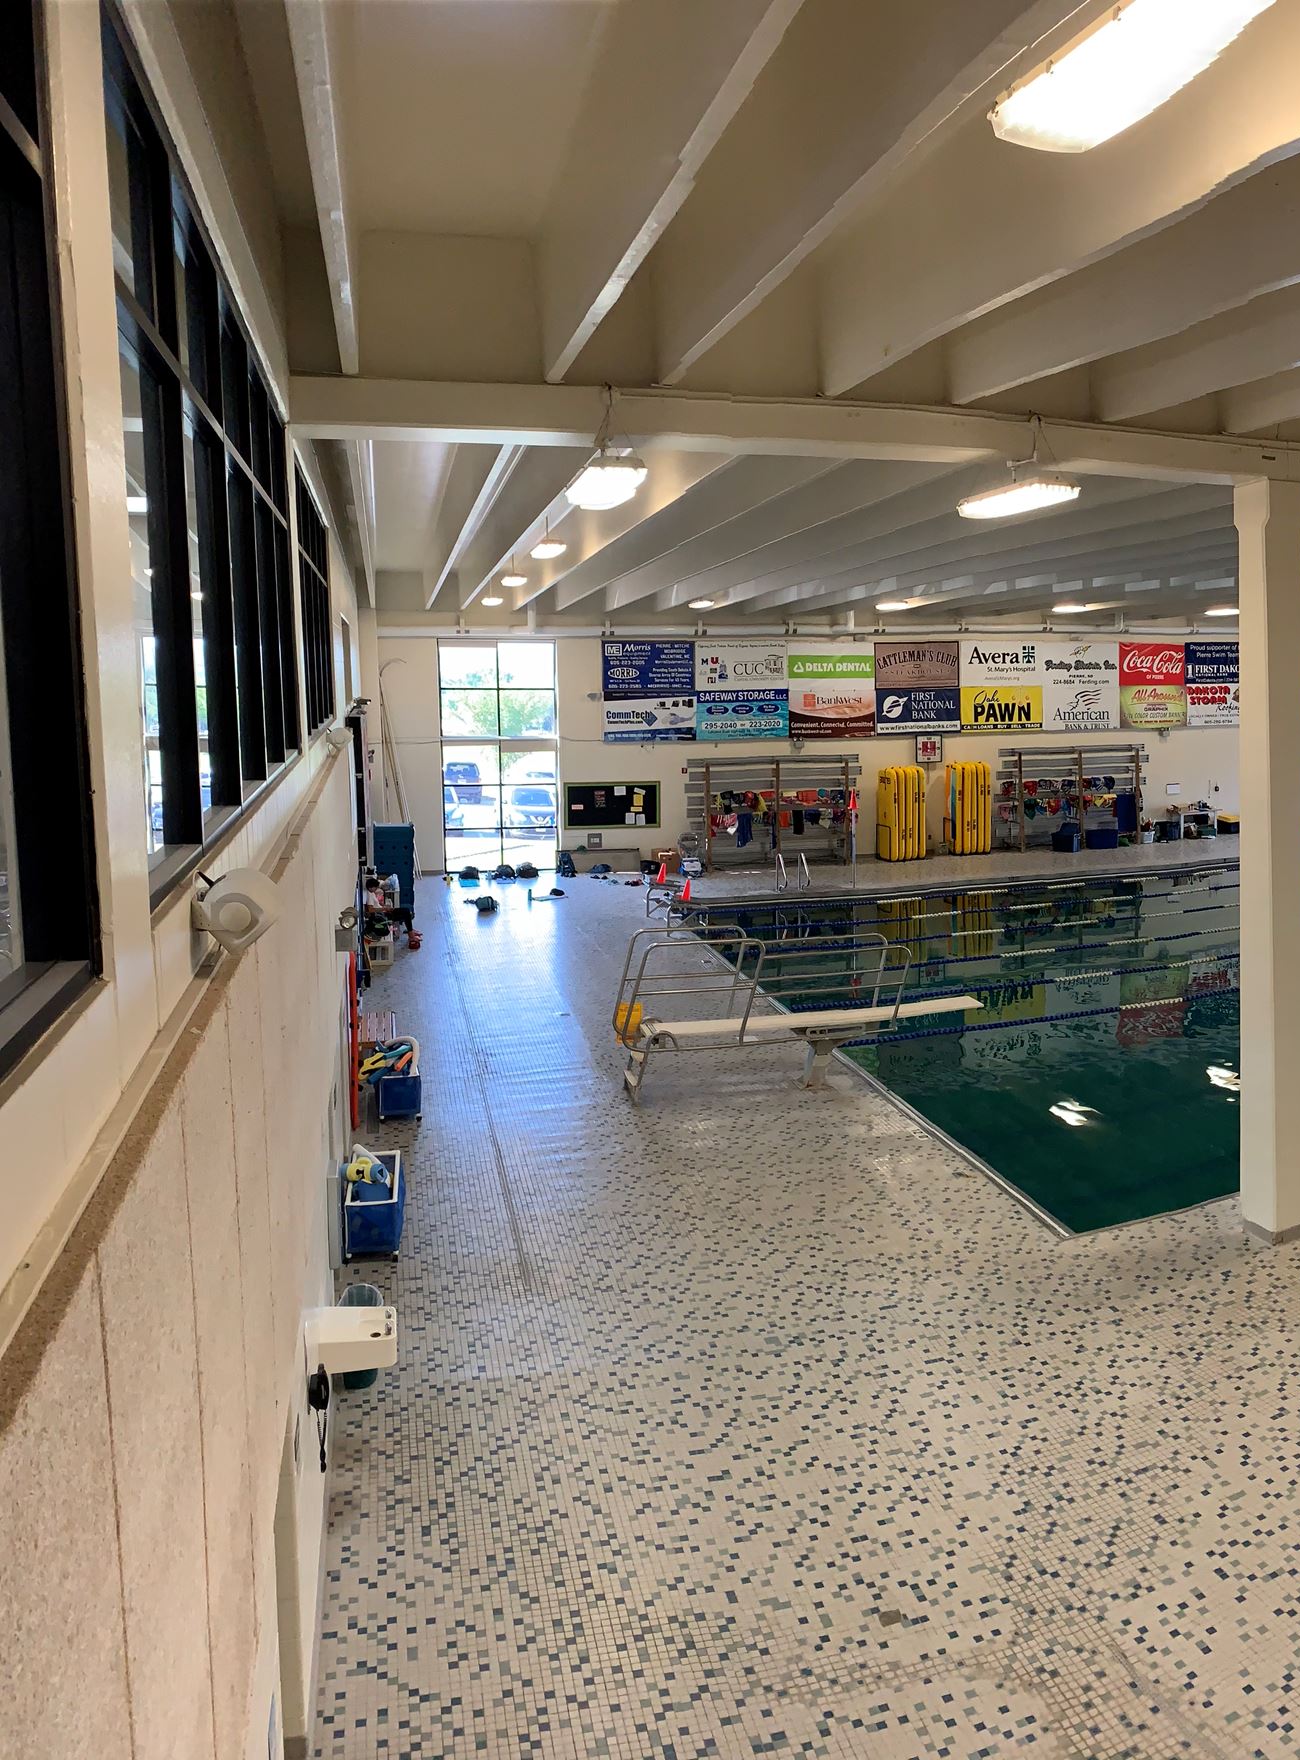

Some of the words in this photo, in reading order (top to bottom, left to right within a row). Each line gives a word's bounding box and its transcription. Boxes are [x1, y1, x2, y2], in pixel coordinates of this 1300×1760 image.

[607, 646, 620, 654] ME
[623, 643, 651, 652] Morris
[876, 649, 935, 670] CATTLEMAN'S
[936, 651, 958, 668] CLUB
[967, 646, 1020, 665] Avera
[1196, 651, 1212, 659] Pierre
[733, 662, 765, 676] CUC
[805, 662, 835, 672] DELTA
[835, 662, 872, 672] DENTAL
[994, 666, 1013, 674] Mary's
[1012, 665, 1036, 673] Hospital
[1195, 664, 1219, 674] FIRST
[609, 668, 638, 678] MORRIS
[1186, 685, 1230, 696] DAKOTA
[699, 692, 737, 702] SAFEWAY
[738, 690, 776, 700] STORAGE
[816, 696, 863, 705] BankWest
[911, 692, 936, 701] FIRST
[1189, 695, 1228, 706] STORM
[911, 700, 957, 710] NATIONAL
[606, 710, 650, 720] CommTech
[911, 710, 937, 720] BANK
[973, 702, 1032, 723] PAWN
[1053, 707, 1111, 721] American
[704, 722, 738, 730] 295-2040
[749, 720, 781, 728] 223-2020
